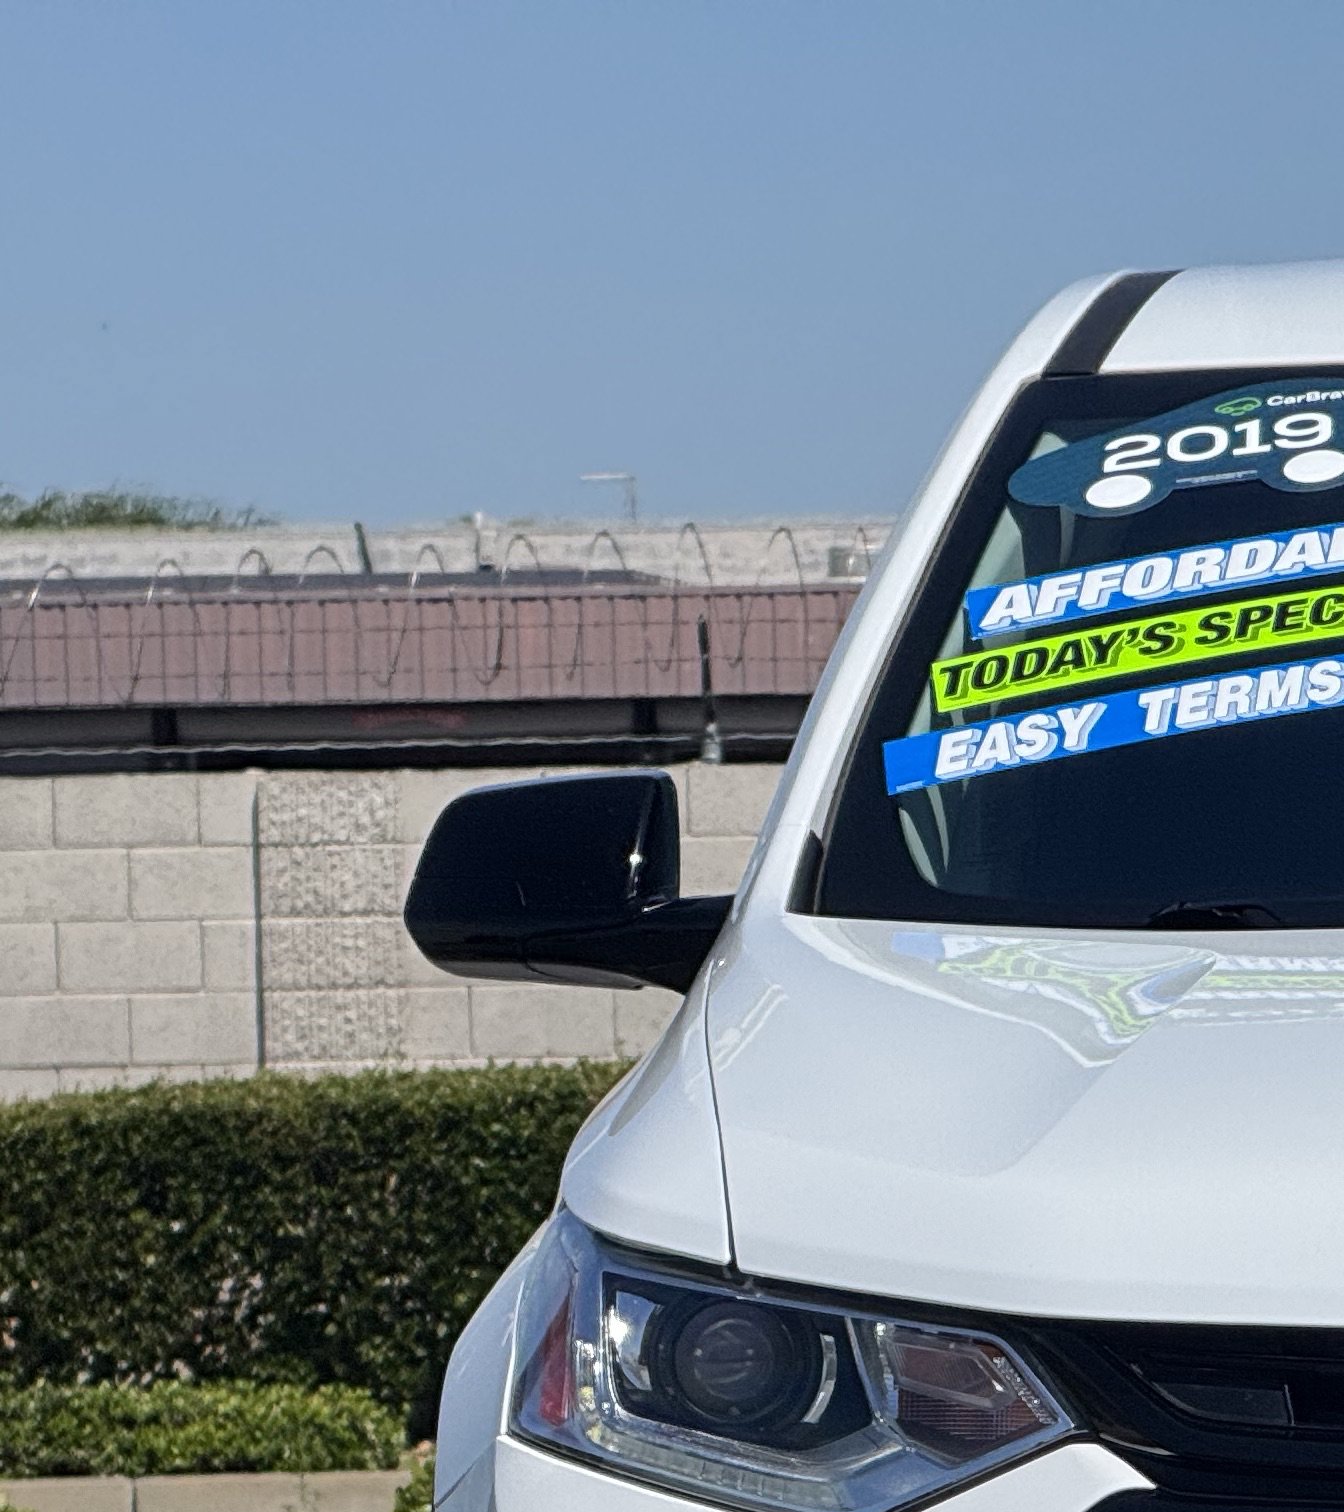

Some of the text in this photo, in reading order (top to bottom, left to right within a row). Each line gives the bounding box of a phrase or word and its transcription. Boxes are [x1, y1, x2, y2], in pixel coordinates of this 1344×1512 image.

[1102, 411, 1335, 474] 2019
[939, 620, 1184, 698] TODAY'S
[935, 702, 1108, 780] EASY
